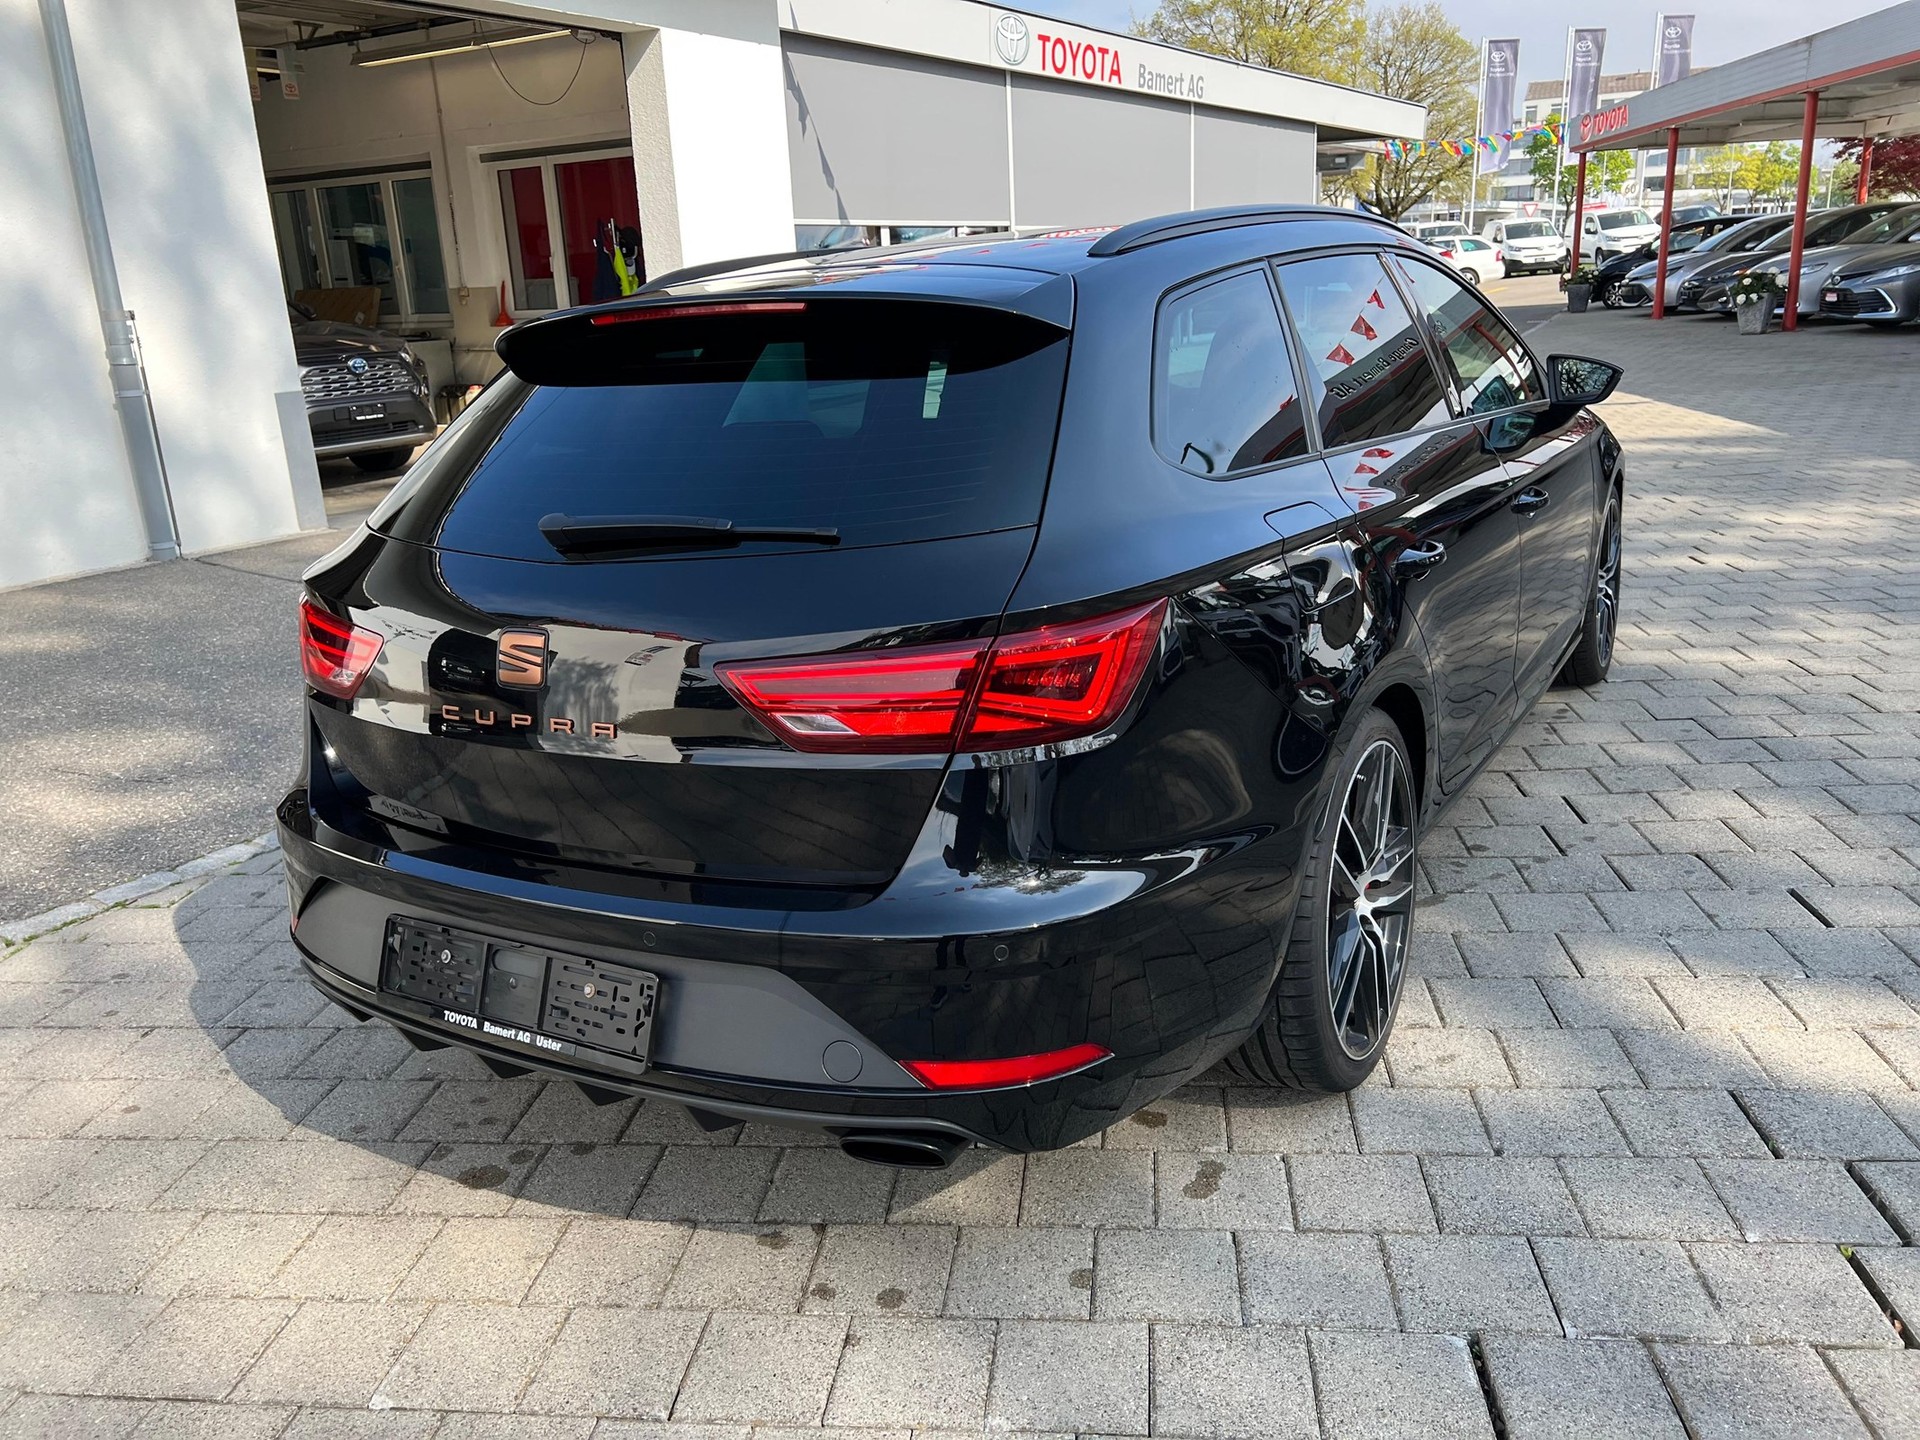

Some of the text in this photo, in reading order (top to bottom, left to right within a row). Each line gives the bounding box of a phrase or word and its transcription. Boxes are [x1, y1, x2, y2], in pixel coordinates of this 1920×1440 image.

[1037, 34, 1204, 99] TOYOTA Bamert AG
[1593, 104, 1629, 135] TOYOTA
[442, 705, 618, 739] CUPRA
[443, 1010, 562, 1051] TOYOTA Bamert AG Uster
